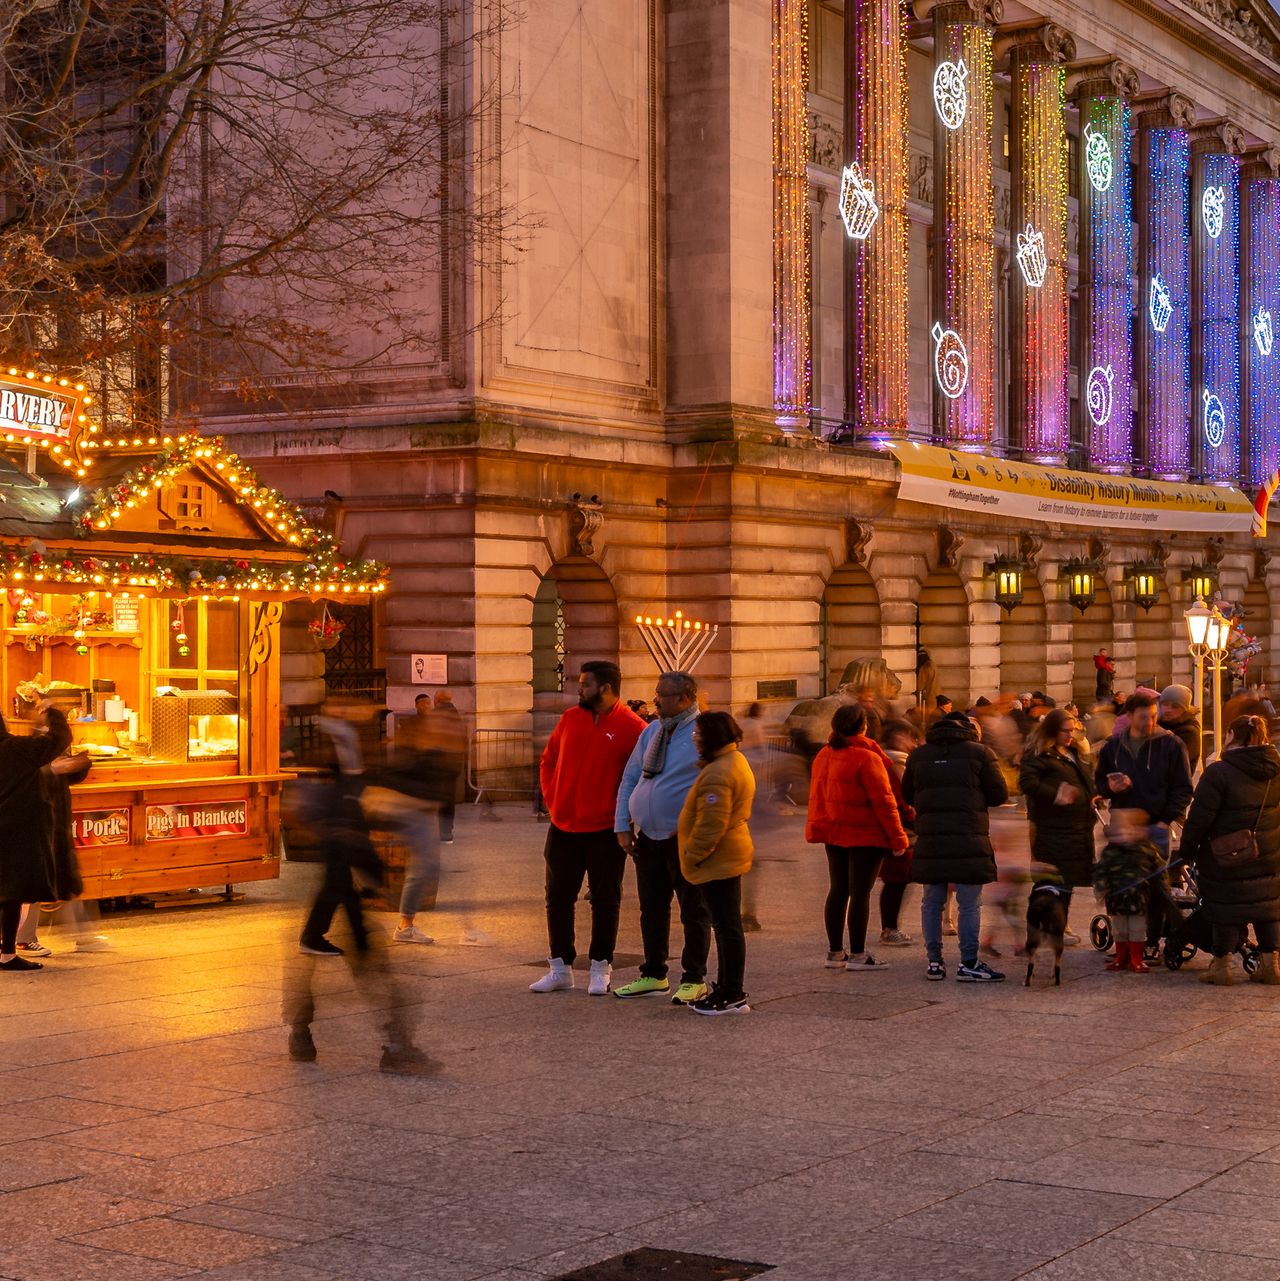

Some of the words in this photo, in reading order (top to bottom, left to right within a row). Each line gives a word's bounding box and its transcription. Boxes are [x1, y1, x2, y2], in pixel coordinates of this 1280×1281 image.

[948, 488, 1000, 505] #NottinghamTogether
[1045, 473, 1095, 500] Disability
[1095, 480, 1131, 504] History
[1129, 483, 1160, 503] Month
[1038, 501, 1052, 512] Learn
[1064, 505, 1080, 517] history
[82, 817, 122, 838] Pork
[147, 814, 174, 832] Pigs
[177, 812, 191, 828] In
[192, 809, 246, 828] Blankets
